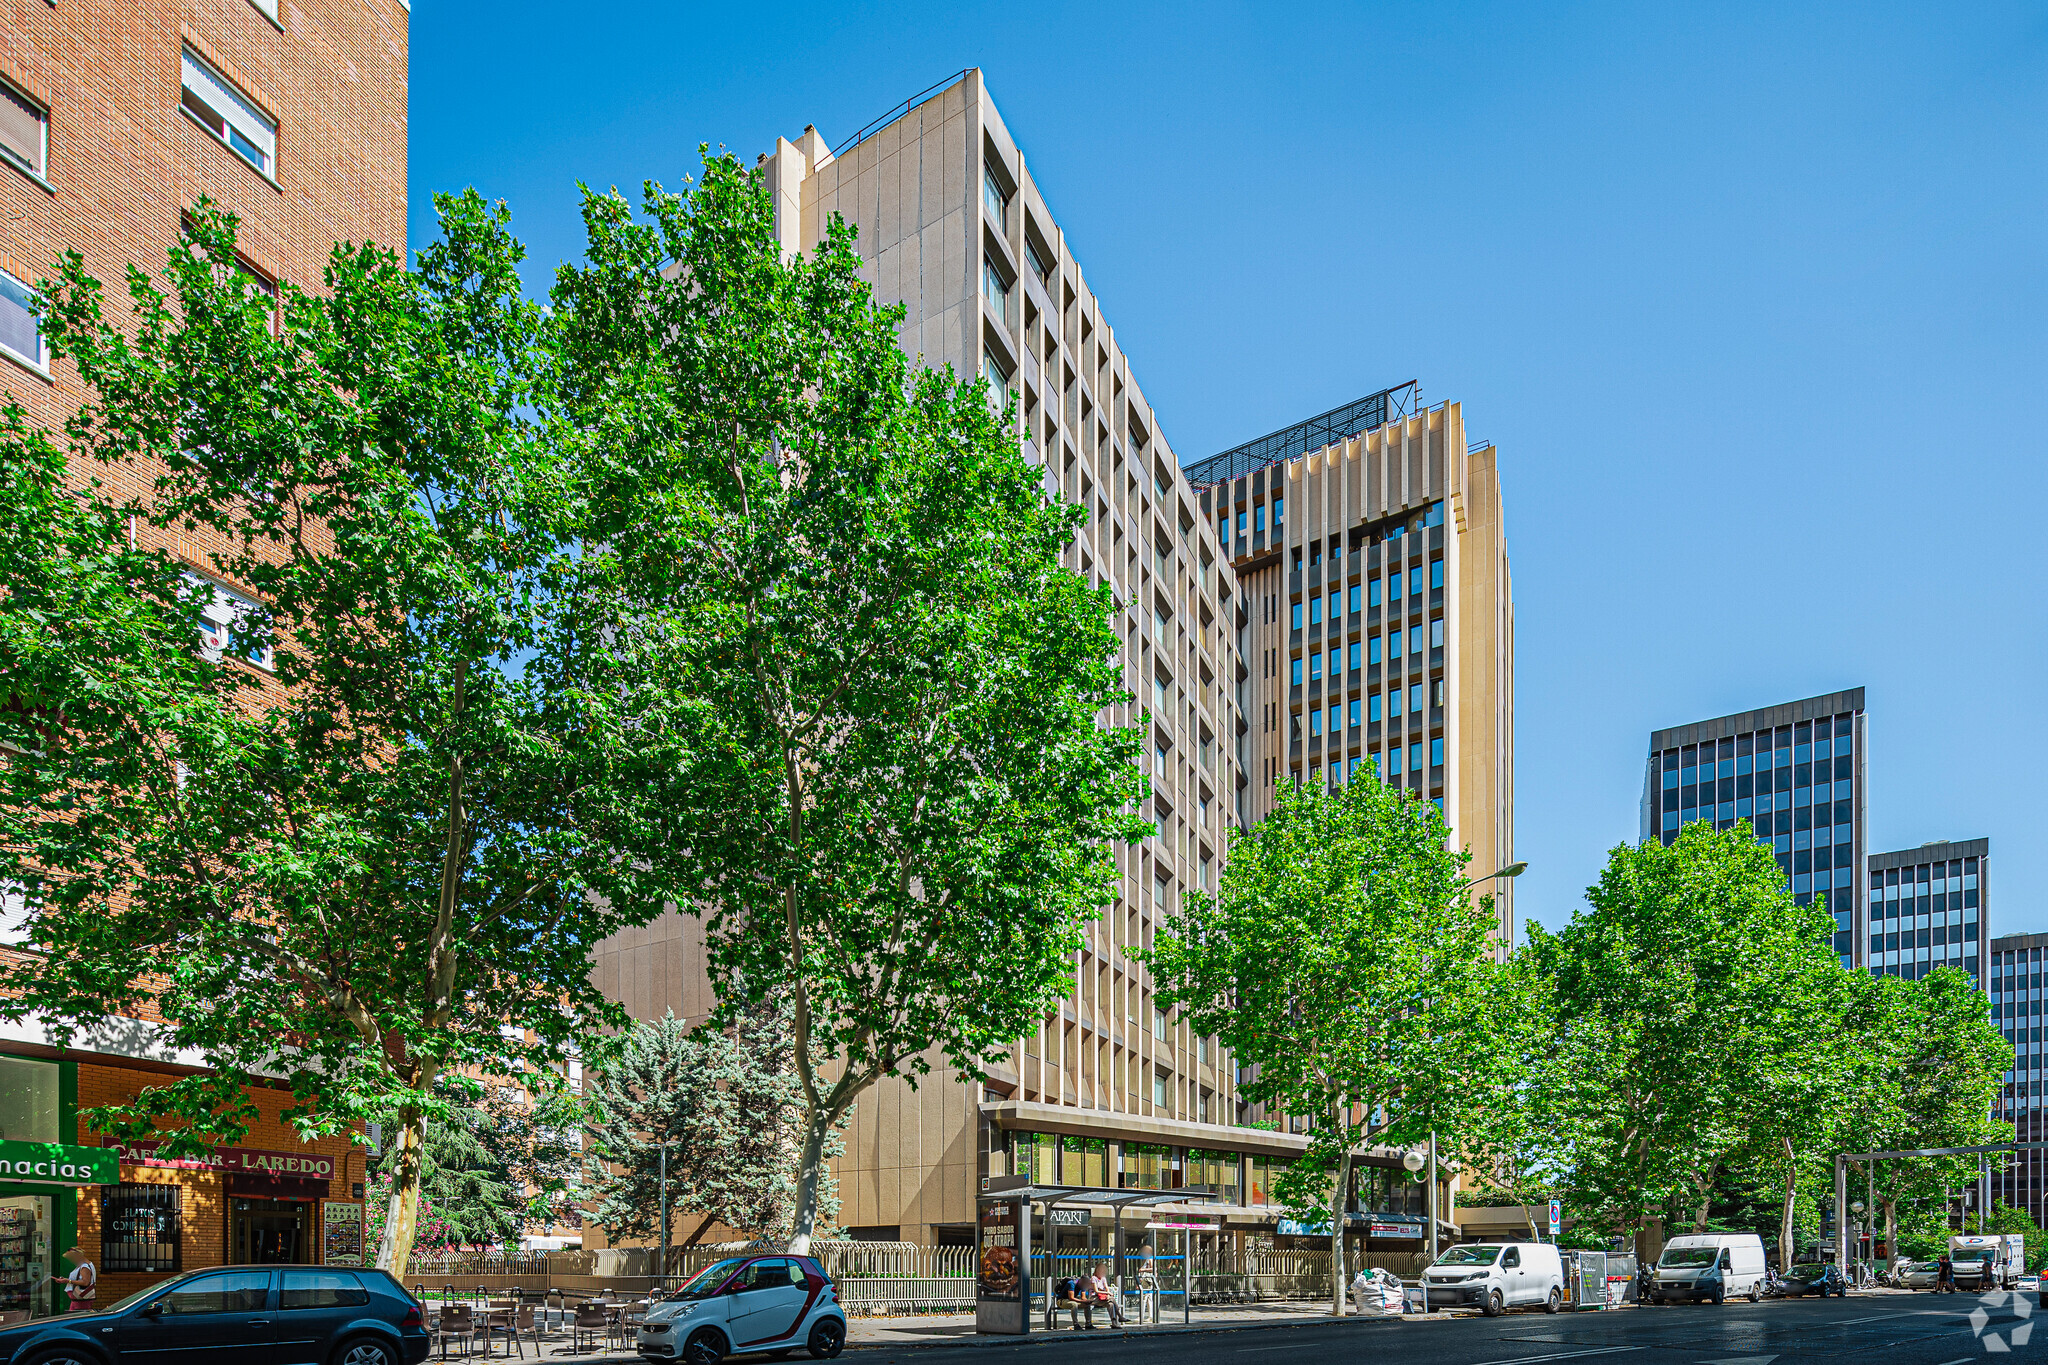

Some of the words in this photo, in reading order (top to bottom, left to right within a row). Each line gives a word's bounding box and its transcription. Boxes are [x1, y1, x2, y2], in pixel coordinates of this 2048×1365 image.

[184, 1150, 222, 1165] BAR
[241, 1153, 331, 1174] LAREDO
[1050, 1211, 1084, 1224] APART
[112, 1221, 165, 1231] COMBNADOS
[984, 1226, 996, 1235] PURO
[997, 1225, 1014, 1234] SABOR
[984, 1235, 993, 1248] QUE
[994, 1234, 1014, 1246] ATRAPA
